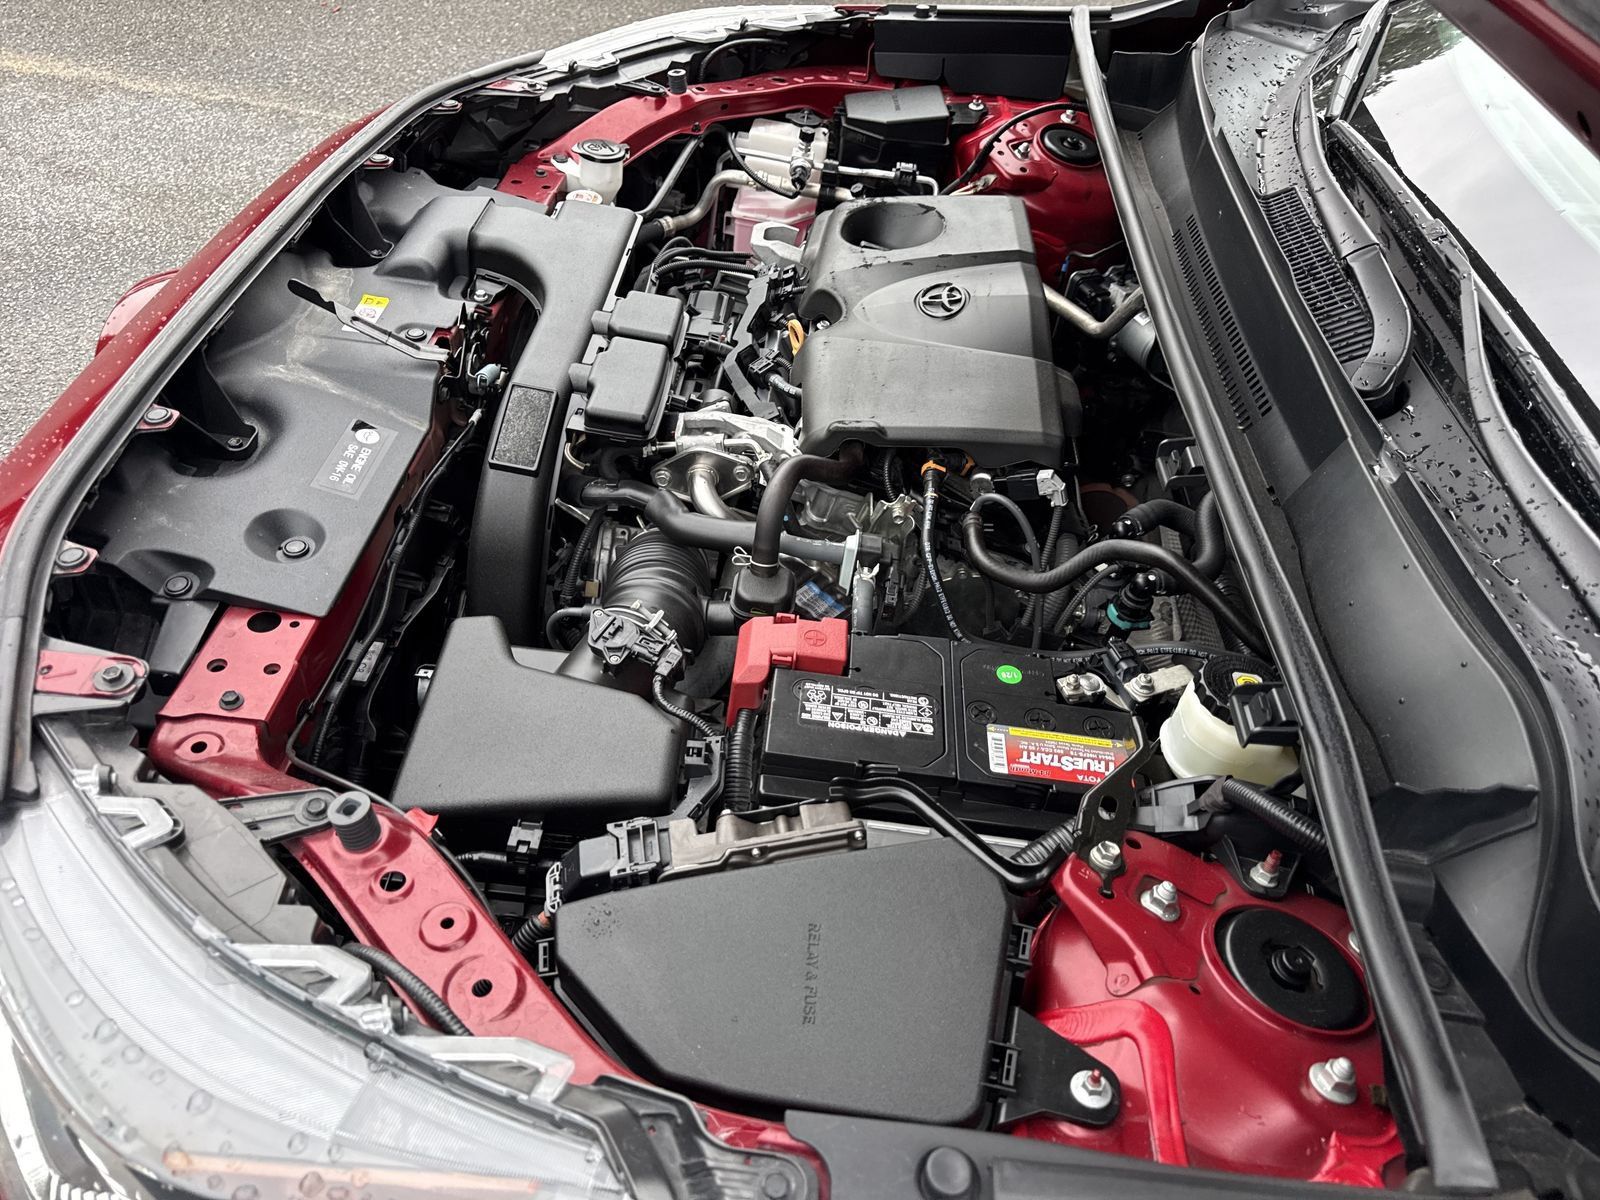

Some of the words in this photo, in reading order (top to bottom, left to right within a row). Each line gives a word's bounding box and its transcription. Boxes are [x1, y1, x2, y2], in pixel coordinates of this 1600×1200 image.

[343, 444, 358, 459] SAE
[350, 447, 372, 473] ENGINE
[329, 460, 349, 482] 0W-16
[342, 473, 357, 485] OIL
[828, 721, 899, 736] DANGER/POISON
[1077, 774, 1102, 783] YOTA
[806, 922, 822, 969] RELAY
[805, 971, 818, 981] &
[802, 986, 818, 1025] FUSE
